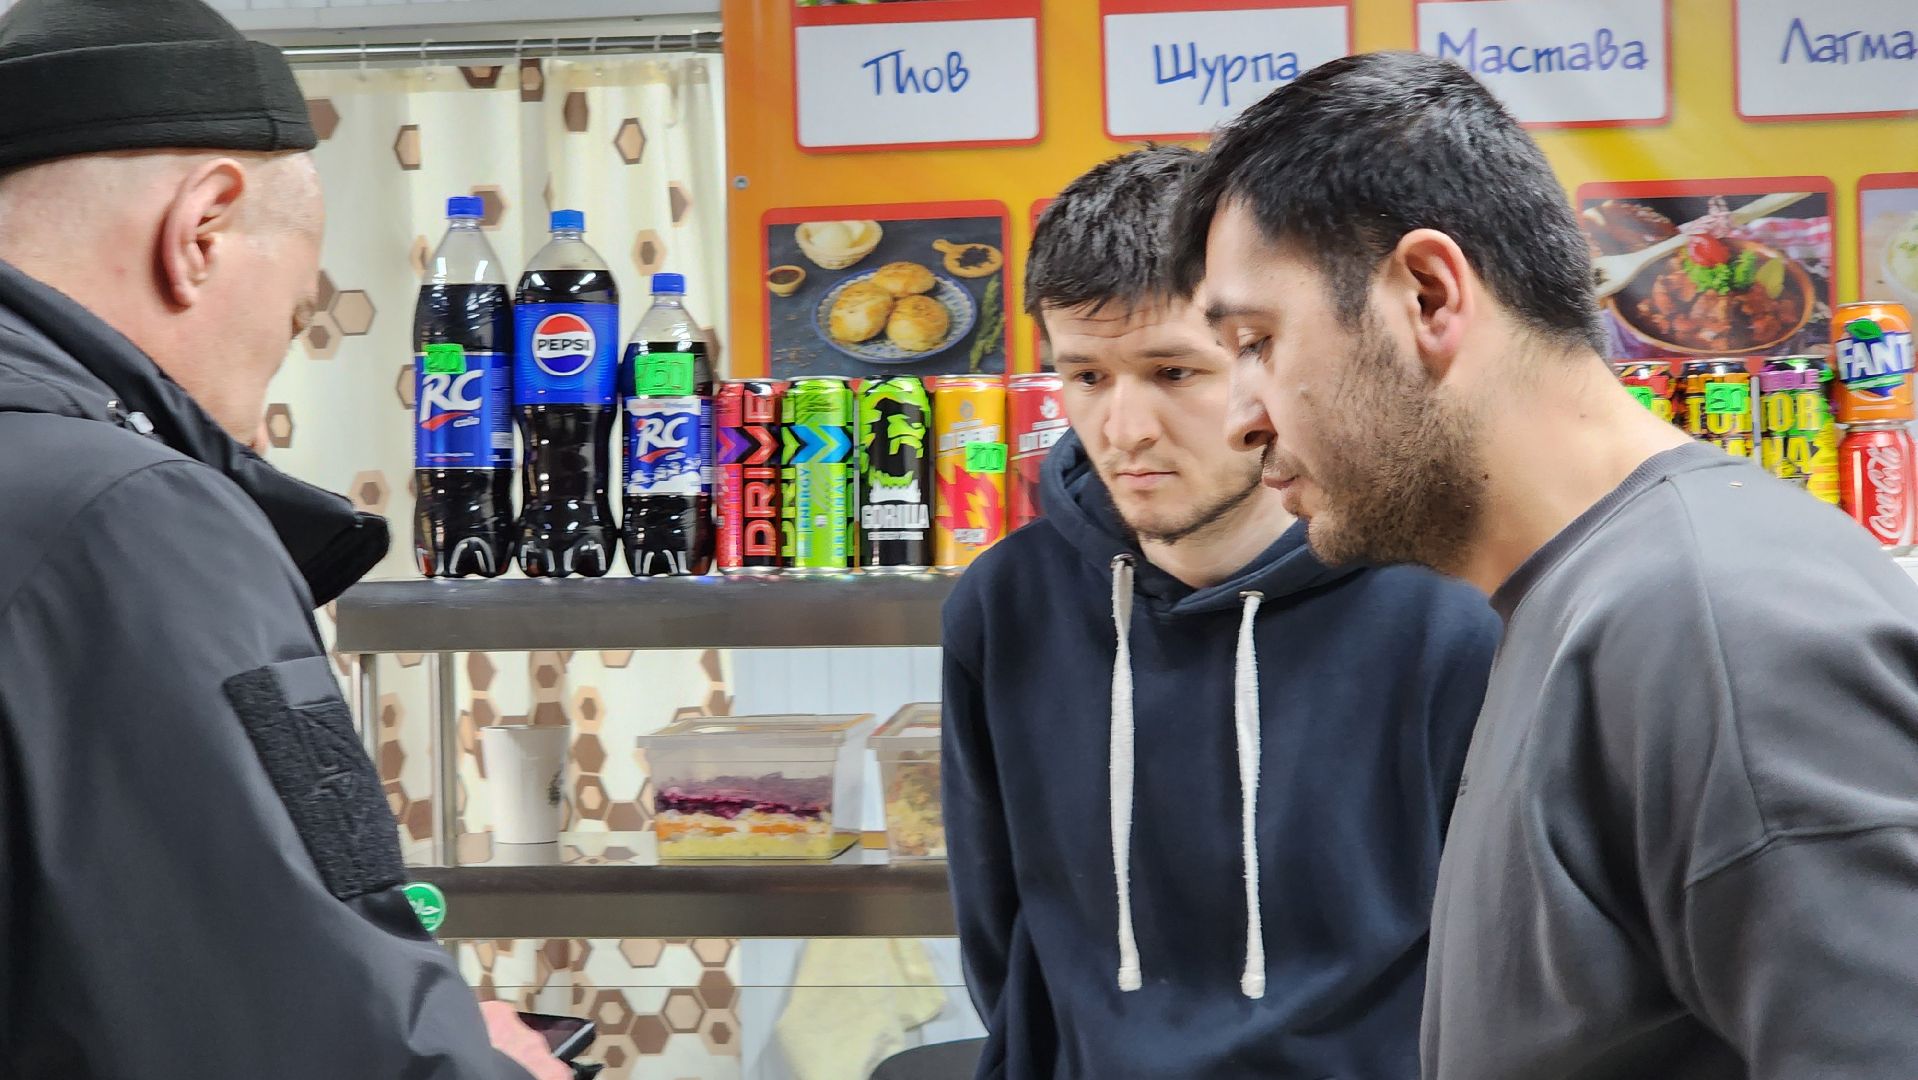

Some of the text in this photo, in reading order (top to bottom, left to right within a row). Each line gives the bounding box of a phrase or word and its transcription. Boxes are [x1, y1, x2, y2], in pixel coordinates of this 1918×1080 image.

[862, 49, 970, 95] Плов
[1153, 42, 1301, 107] Шурпа
[1437, 27, 1649, 75] Мастава
[537, 338, 590, 351] PEPSI
[419, 369, 485, 423] RC
[635, 416, 689, 457] RC
[744, 391, 777, 557] DRIVE
[861, 503, 930, 529] GORILLA
